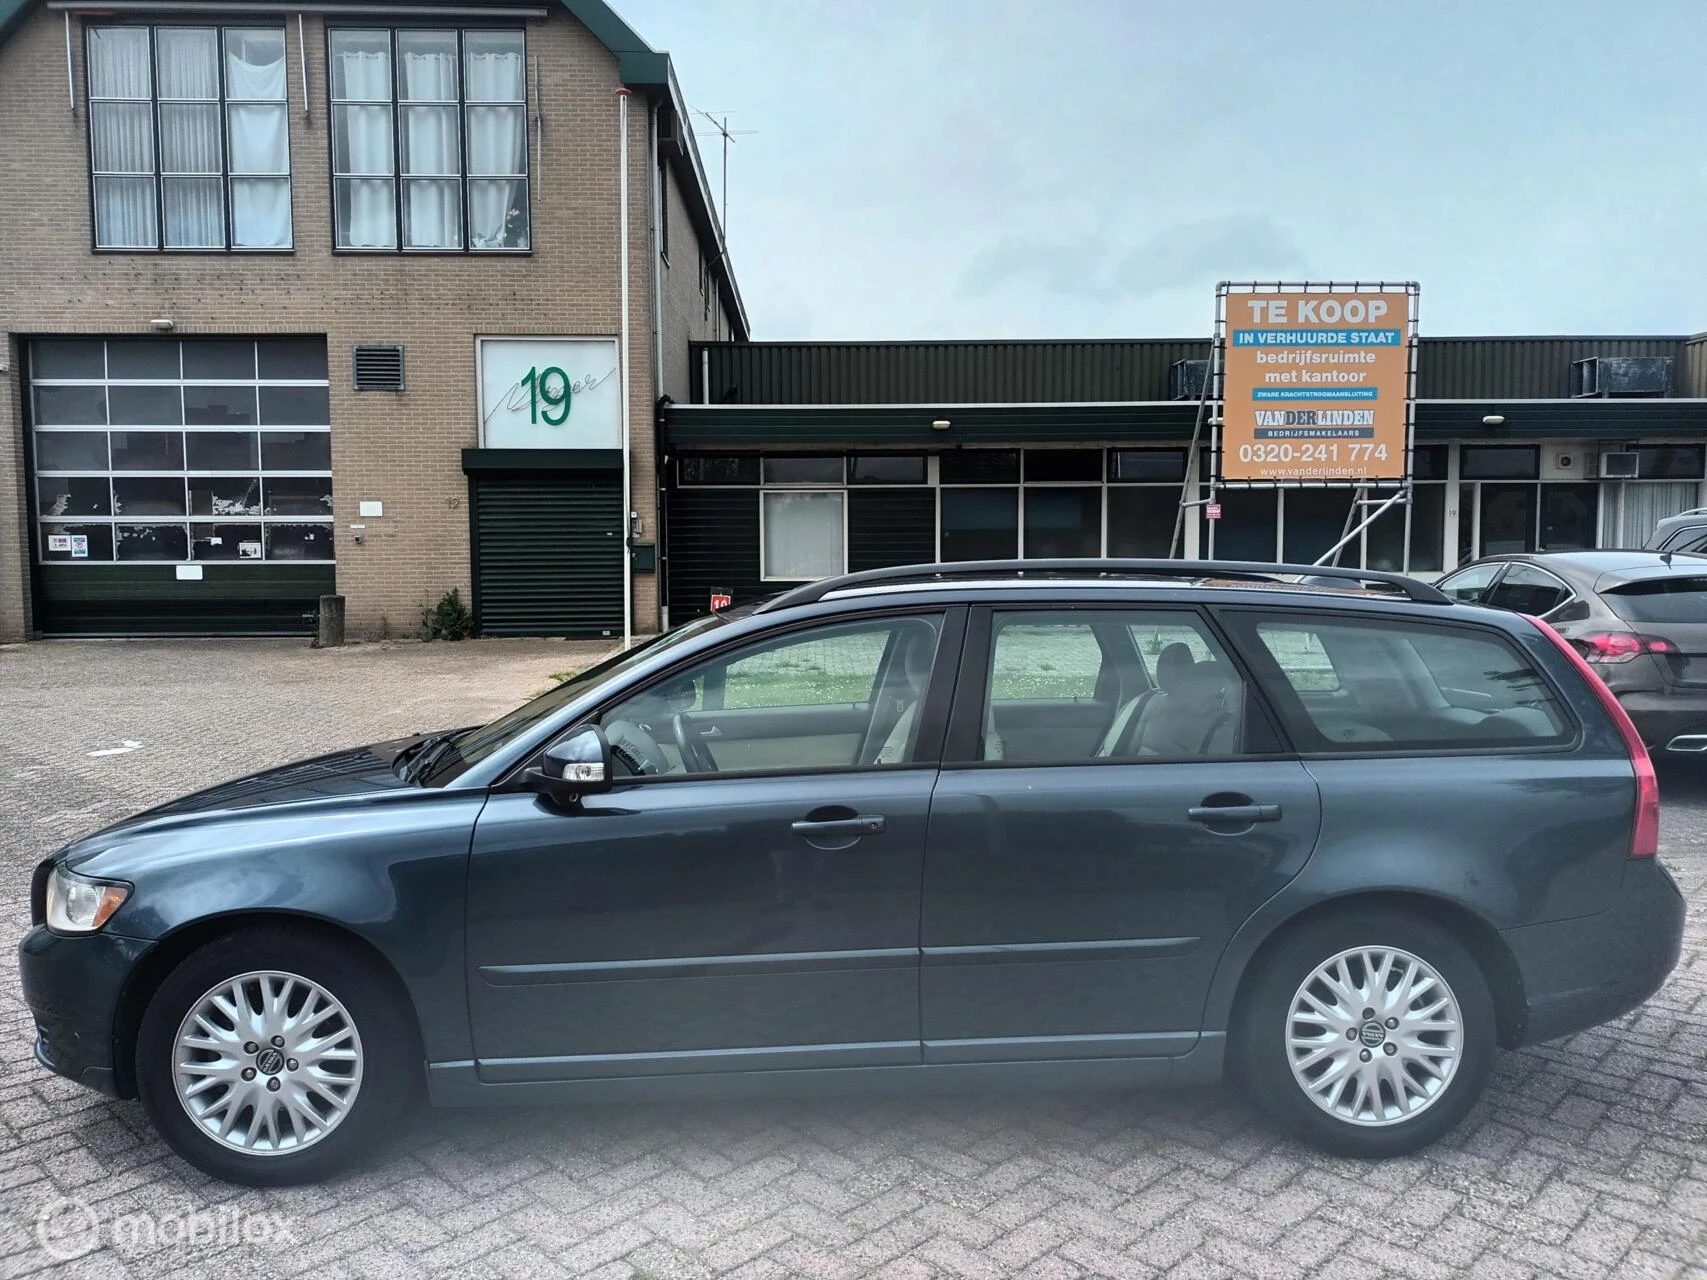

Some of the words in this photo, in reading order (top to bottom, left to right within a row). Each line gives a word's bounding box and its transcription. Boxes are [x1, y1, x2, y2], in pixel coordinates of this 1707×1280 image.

[1248, 300, 1288, 323] TE
[1297, 299, 1388, 323] KOOP
[1239, 332, 1254, 344] IN
[1257, 332, 1347, 344] VERHUURDE
[1350, 332, 1394, 344] STAAT
[1256, 351, 1376, 366] bedrijfsruimte
[1264, 371, 1297, 383] met
[1301, 370, 1367, 383] kantoor
[521, 366, 571, 426] 19
[1267, 430, 1360, 438] BEDRIJFSMAKELAARS
[1239, 444, 1338, 462] 0320-241
[1348, 443, 1388, 461] 774
[1260, 466, 1367, 475] www.vanderlinden.nl
